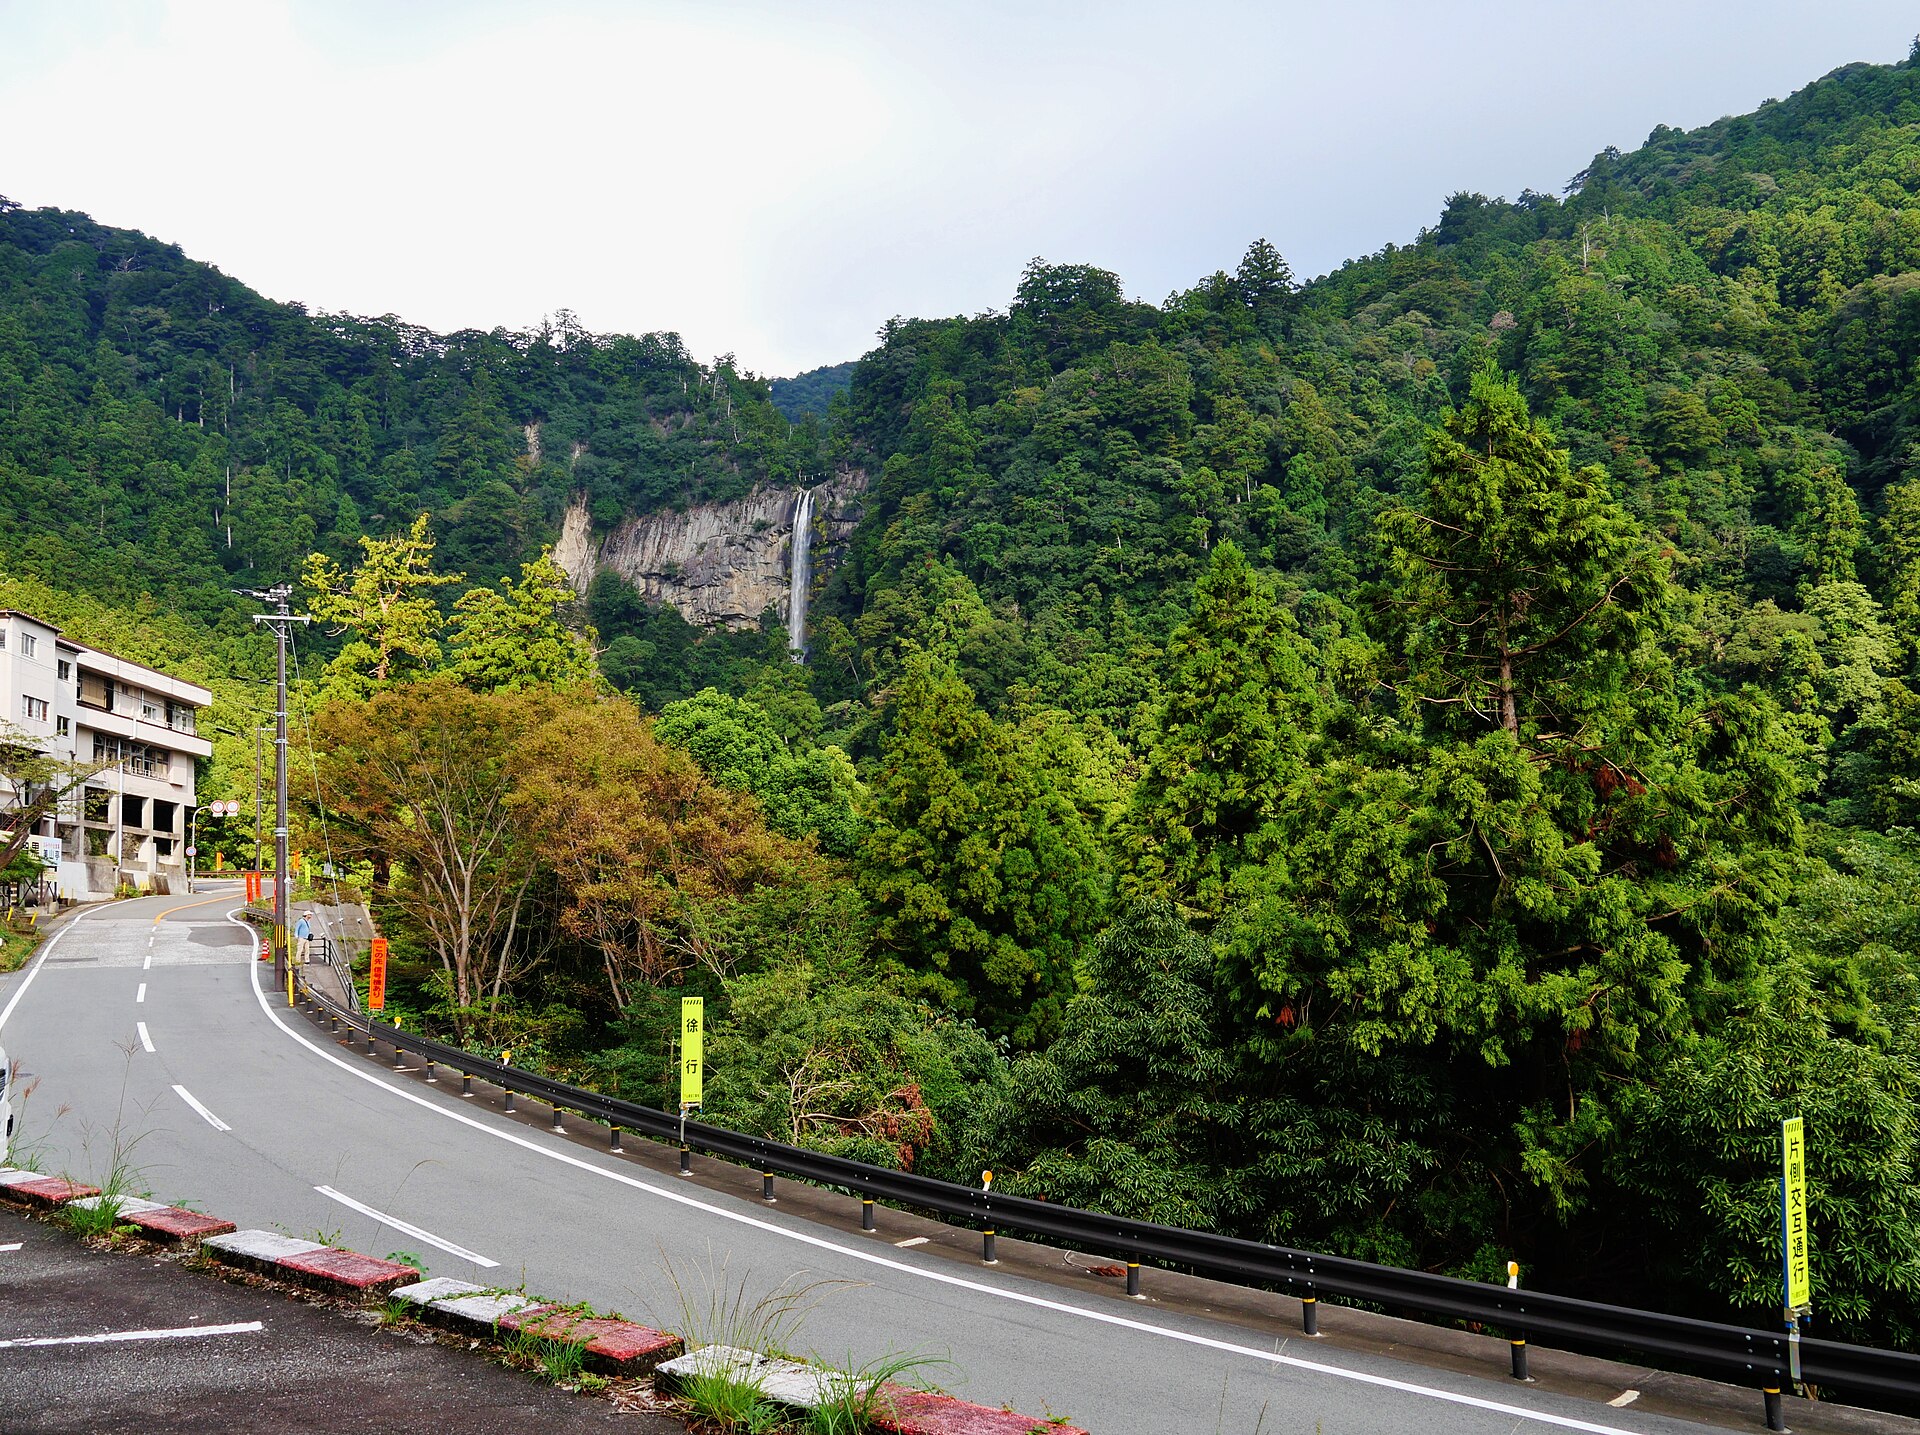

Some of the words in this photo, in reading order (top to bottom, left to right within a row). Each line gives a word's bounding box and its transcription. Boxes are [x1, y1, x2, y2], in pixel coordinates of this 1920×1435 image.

[686, 1018, 698, 1074] 徐行
[1789, 1137, 1804, 1284] 片側交互通行
